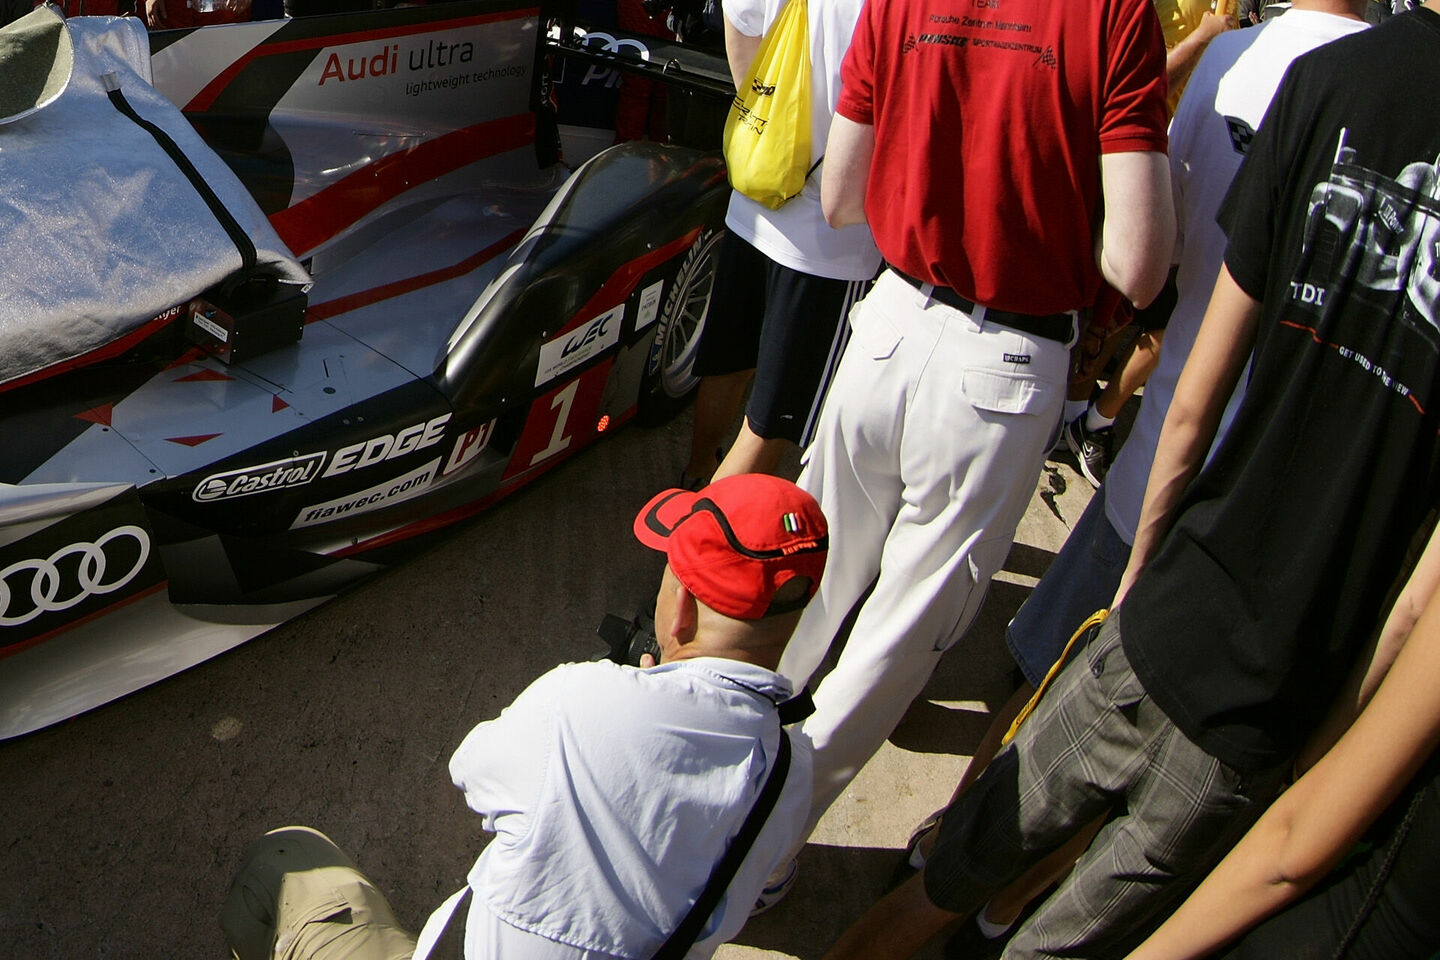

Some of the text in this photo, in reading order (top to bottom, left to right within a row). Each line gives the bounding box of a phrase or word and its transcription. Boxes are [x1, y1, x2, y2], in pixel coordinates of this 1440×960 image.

[318, 40, 474, 86] Audi ultra
[405, 63, 527, 96] lightweight technology
[656, 231, 705, 346] MICHELIN
[1290, 281, 1326, 307] TDI
[560, 312, 614, 359] WEC
[1338, 346, 1354, 359] GET
[1354, 353, 1371, 371] USED
[455, 422, 491, 465] P1
[529, 378, 581, 467] 1
[226, 412, 453, 495] Castrol EDGE
[304, 470, 431, 522] fiawec.com
